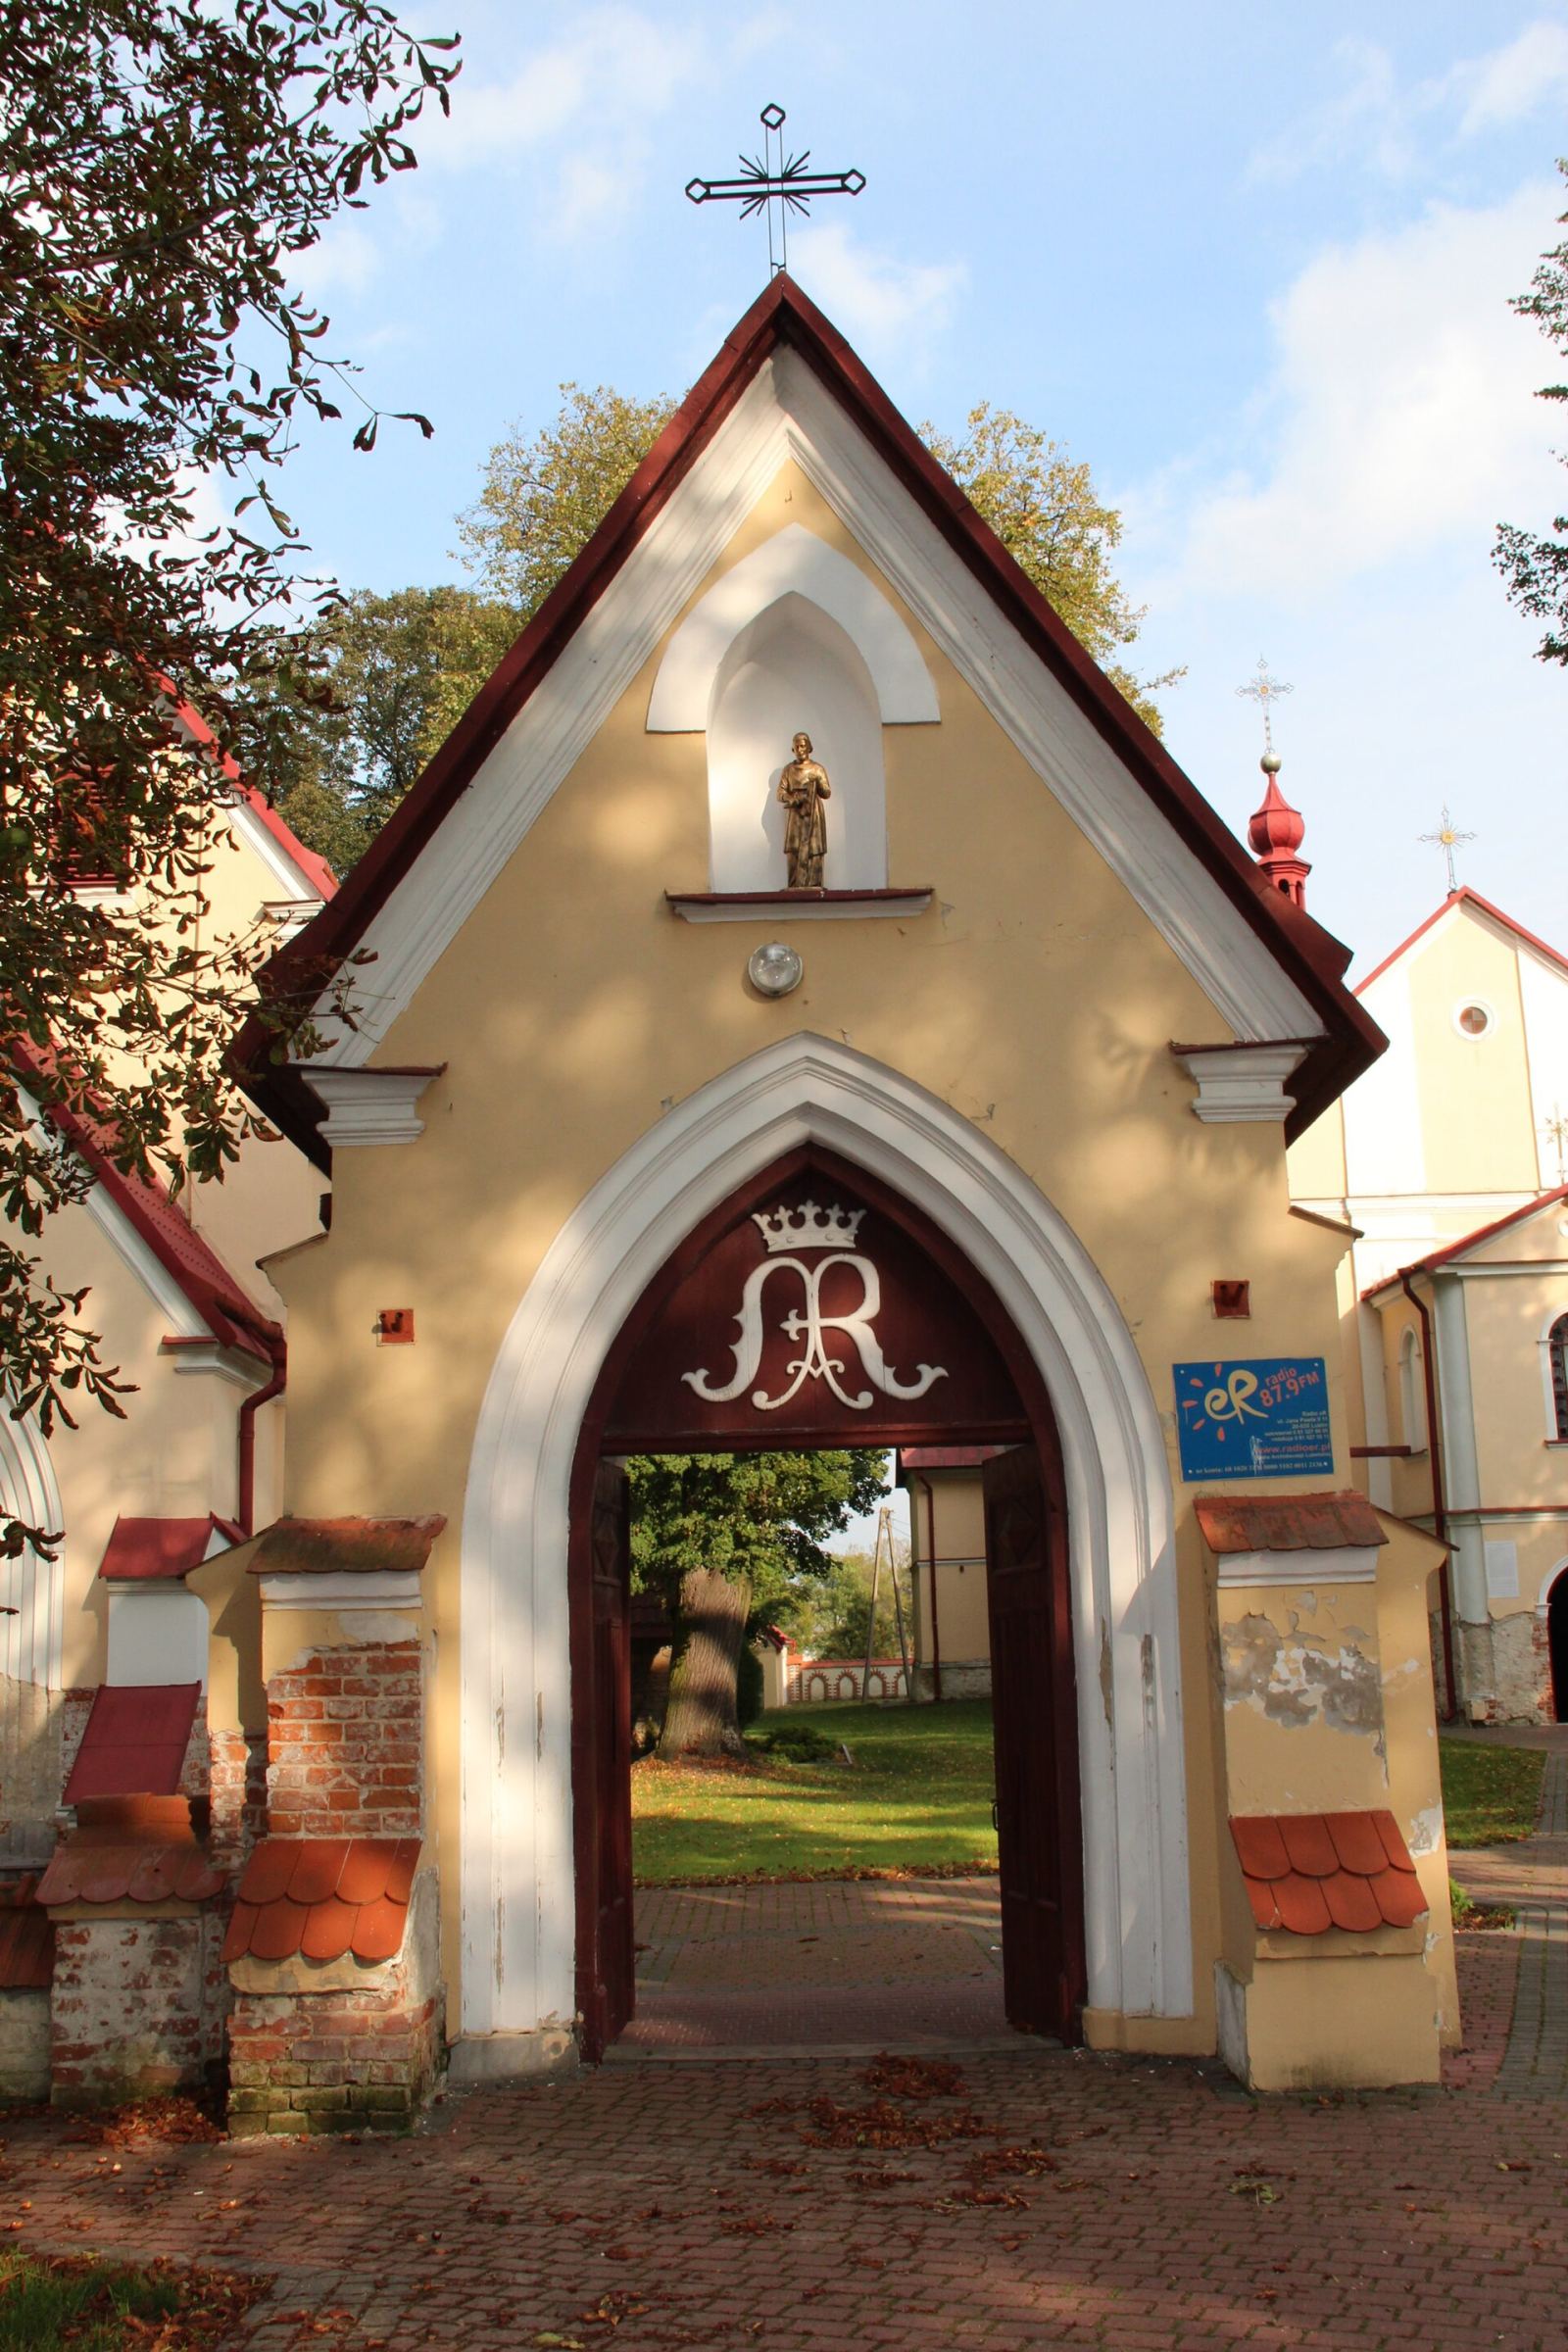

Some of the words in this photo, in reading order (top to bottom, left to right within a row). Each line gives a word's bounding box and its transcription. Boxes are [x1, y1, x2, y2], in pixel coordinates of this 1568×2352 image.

[1259, 1379, 1299, 1407] 87.9
[1299, 1371, 1319, 1389] FM
[1265, 1367, 1297, 1387] radio
